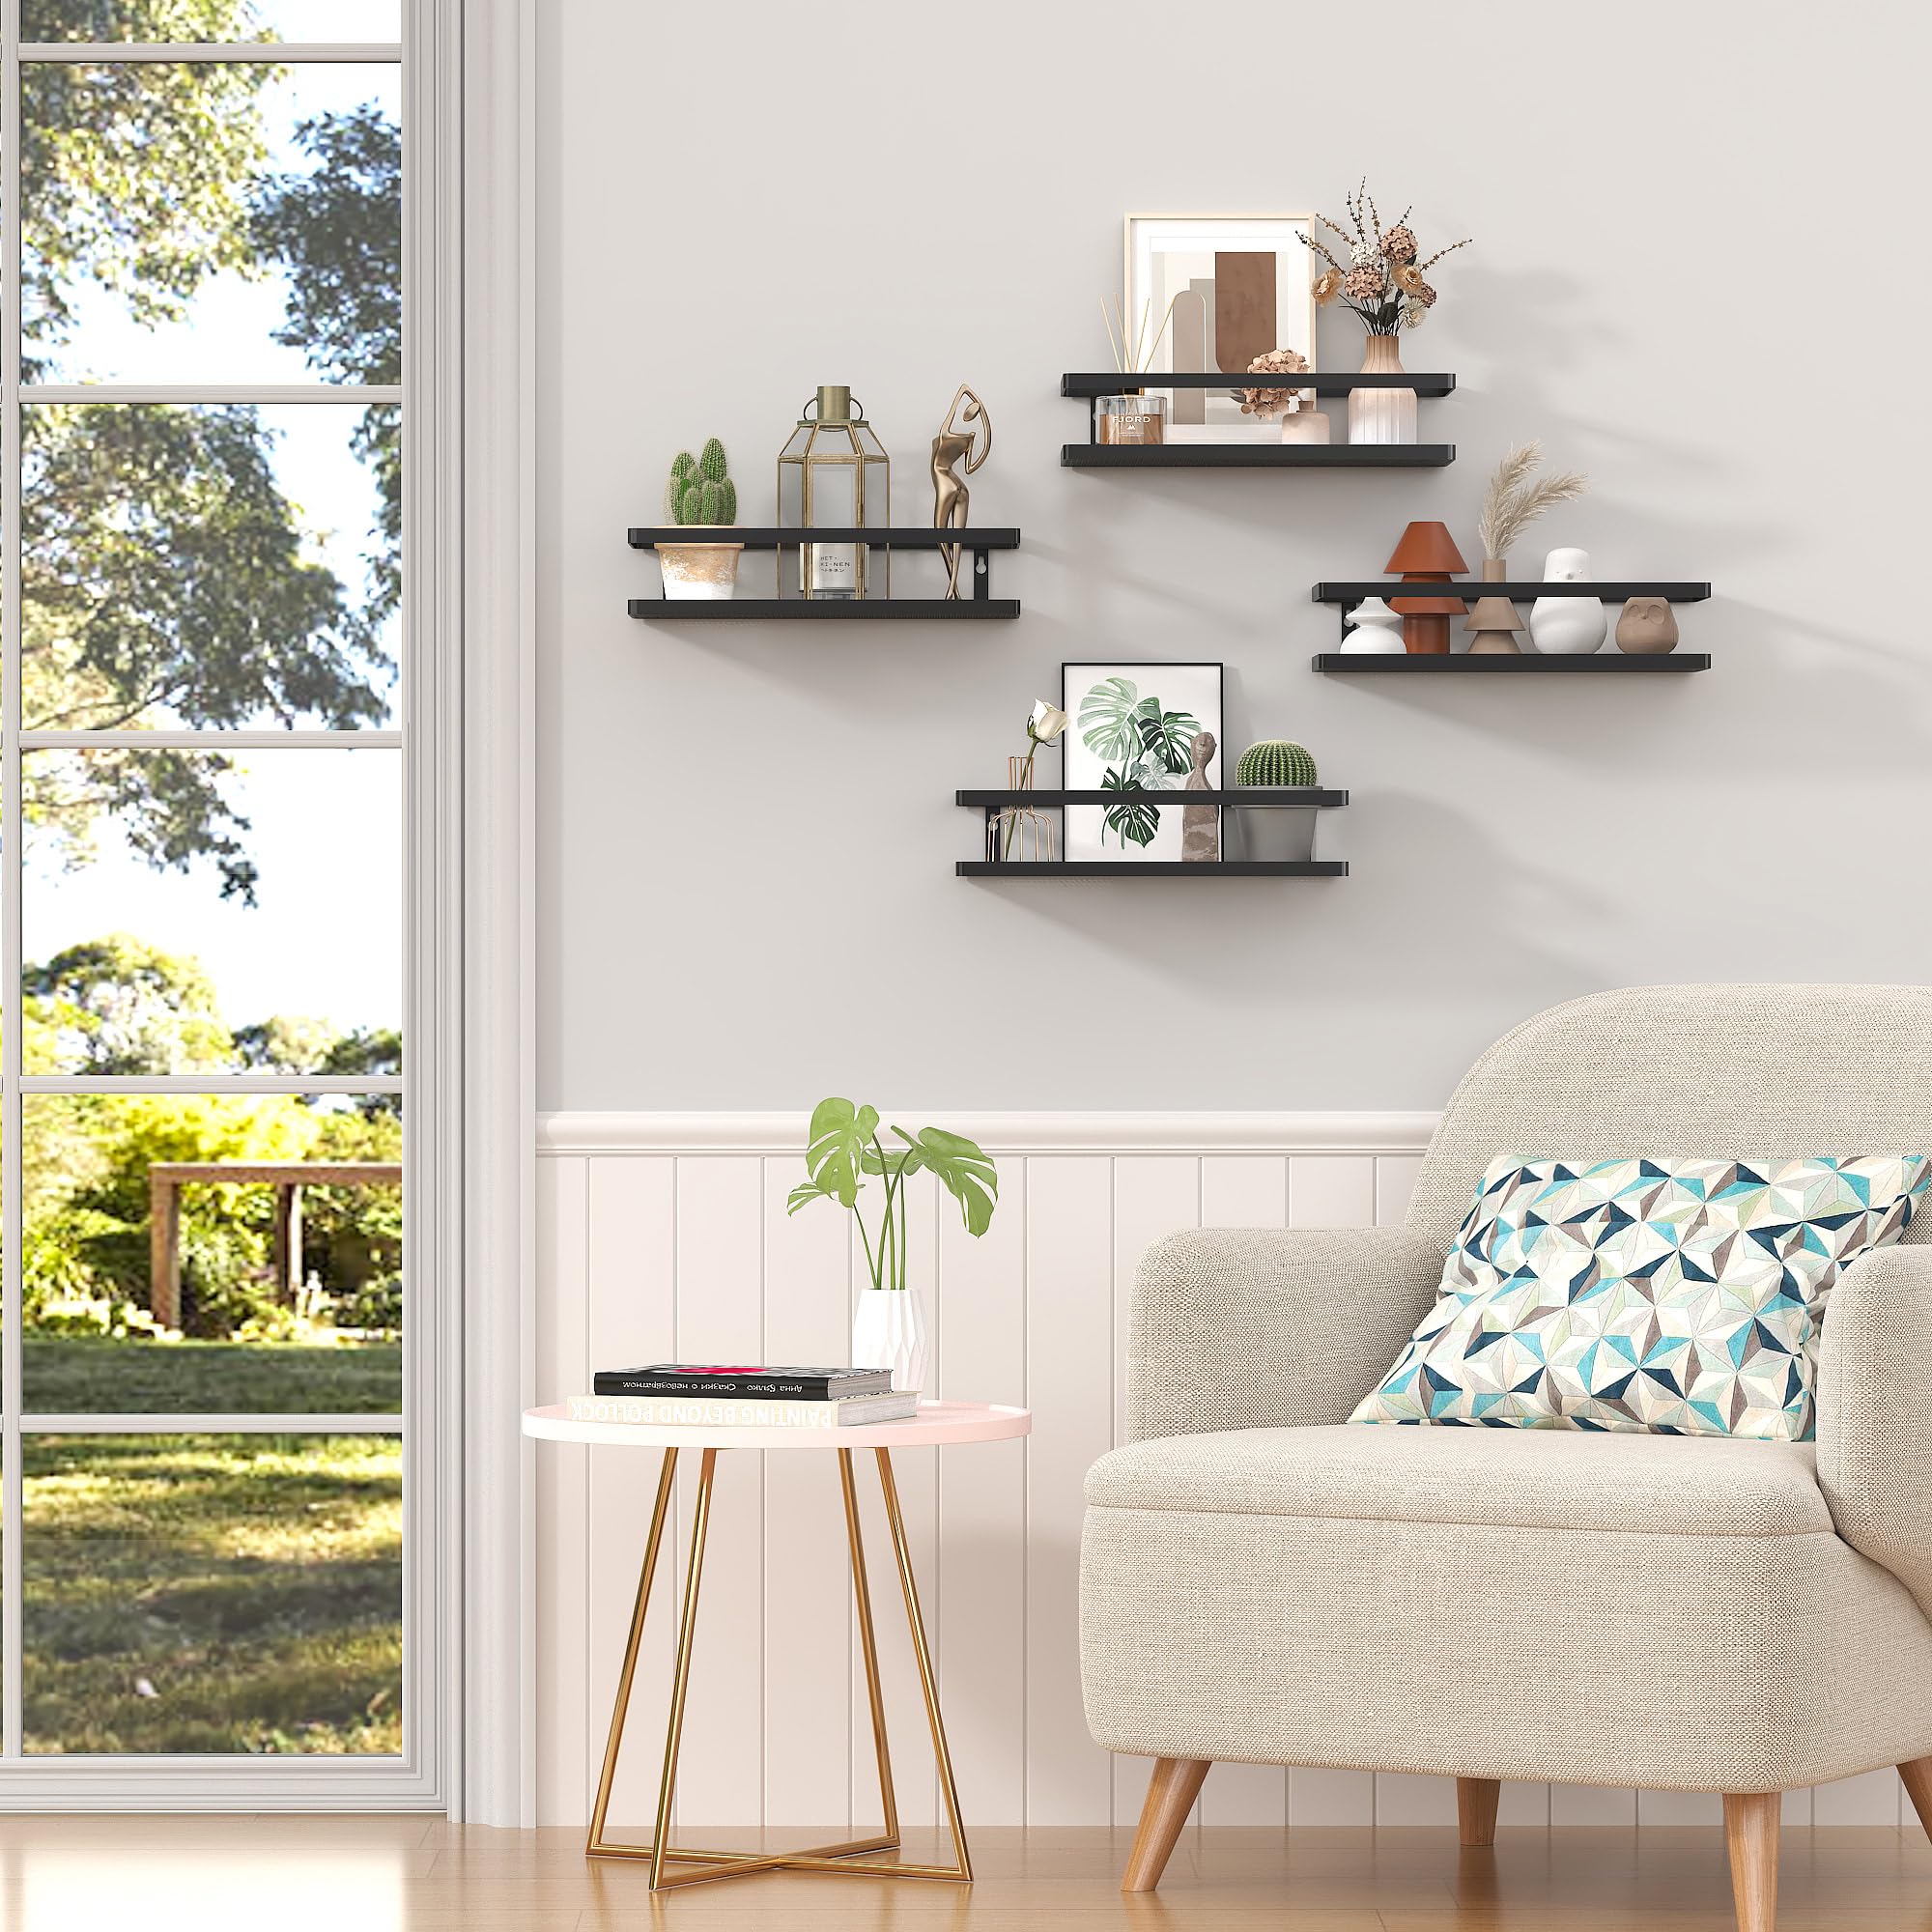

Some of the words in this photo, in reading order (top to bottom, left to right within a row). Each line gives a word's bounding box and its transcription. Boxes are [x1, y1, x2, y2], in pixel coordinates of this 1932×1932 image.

[622, 1380, 689, 1391] невозвратном
[700, 1382, 737, 1392] Сказки
[779, 1384, 803, 1393] Анна
[570, 1403, 654, 1423] POLLOCK
[660, 1406, 735, 1425] BEYOND
[741, 1406, 831, 1426] PAINTING
